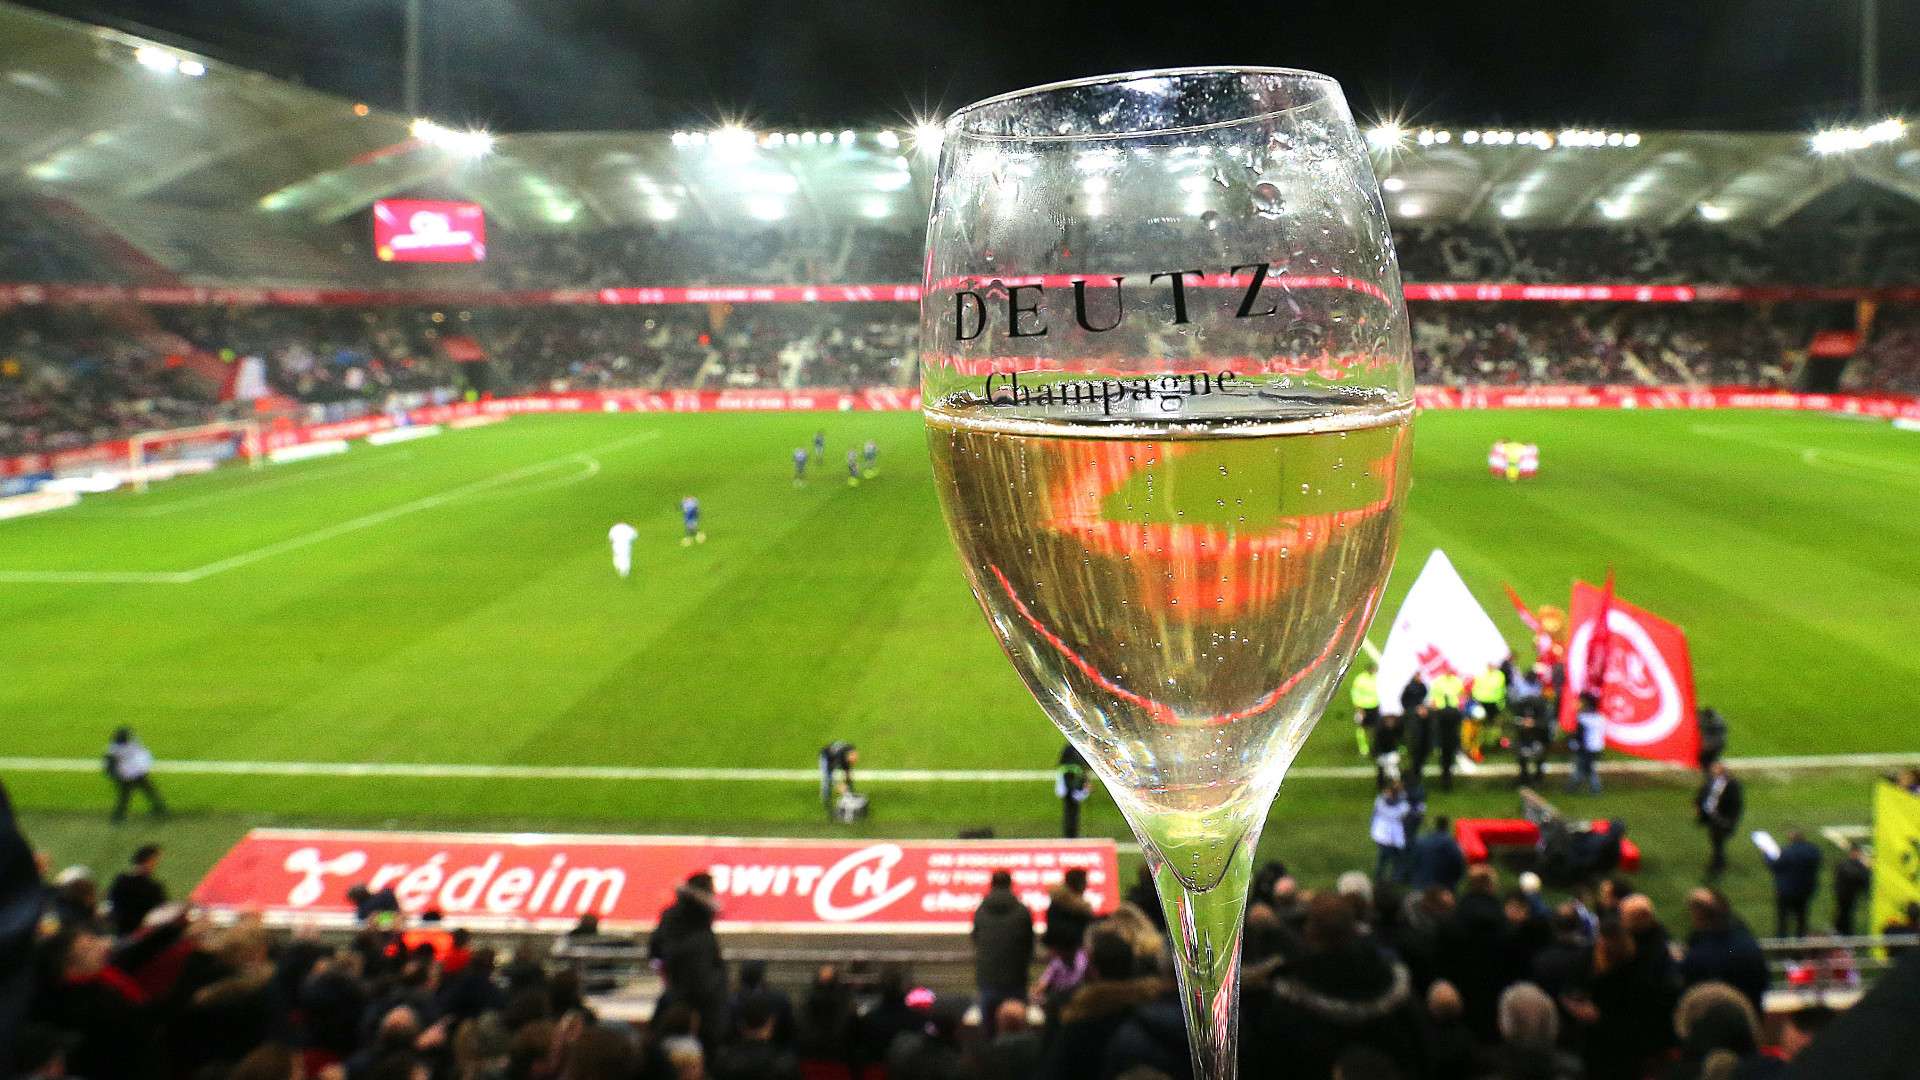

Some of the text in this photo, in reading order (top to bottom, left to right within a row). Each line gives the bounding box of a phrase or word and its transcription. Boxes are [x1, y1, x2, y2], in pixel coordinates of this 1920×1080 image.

[954, 263, 1279, 341] DEUTZ
[985, 370, 1237, 415] Champagne
[366, 851, 627, 914] rédeim
